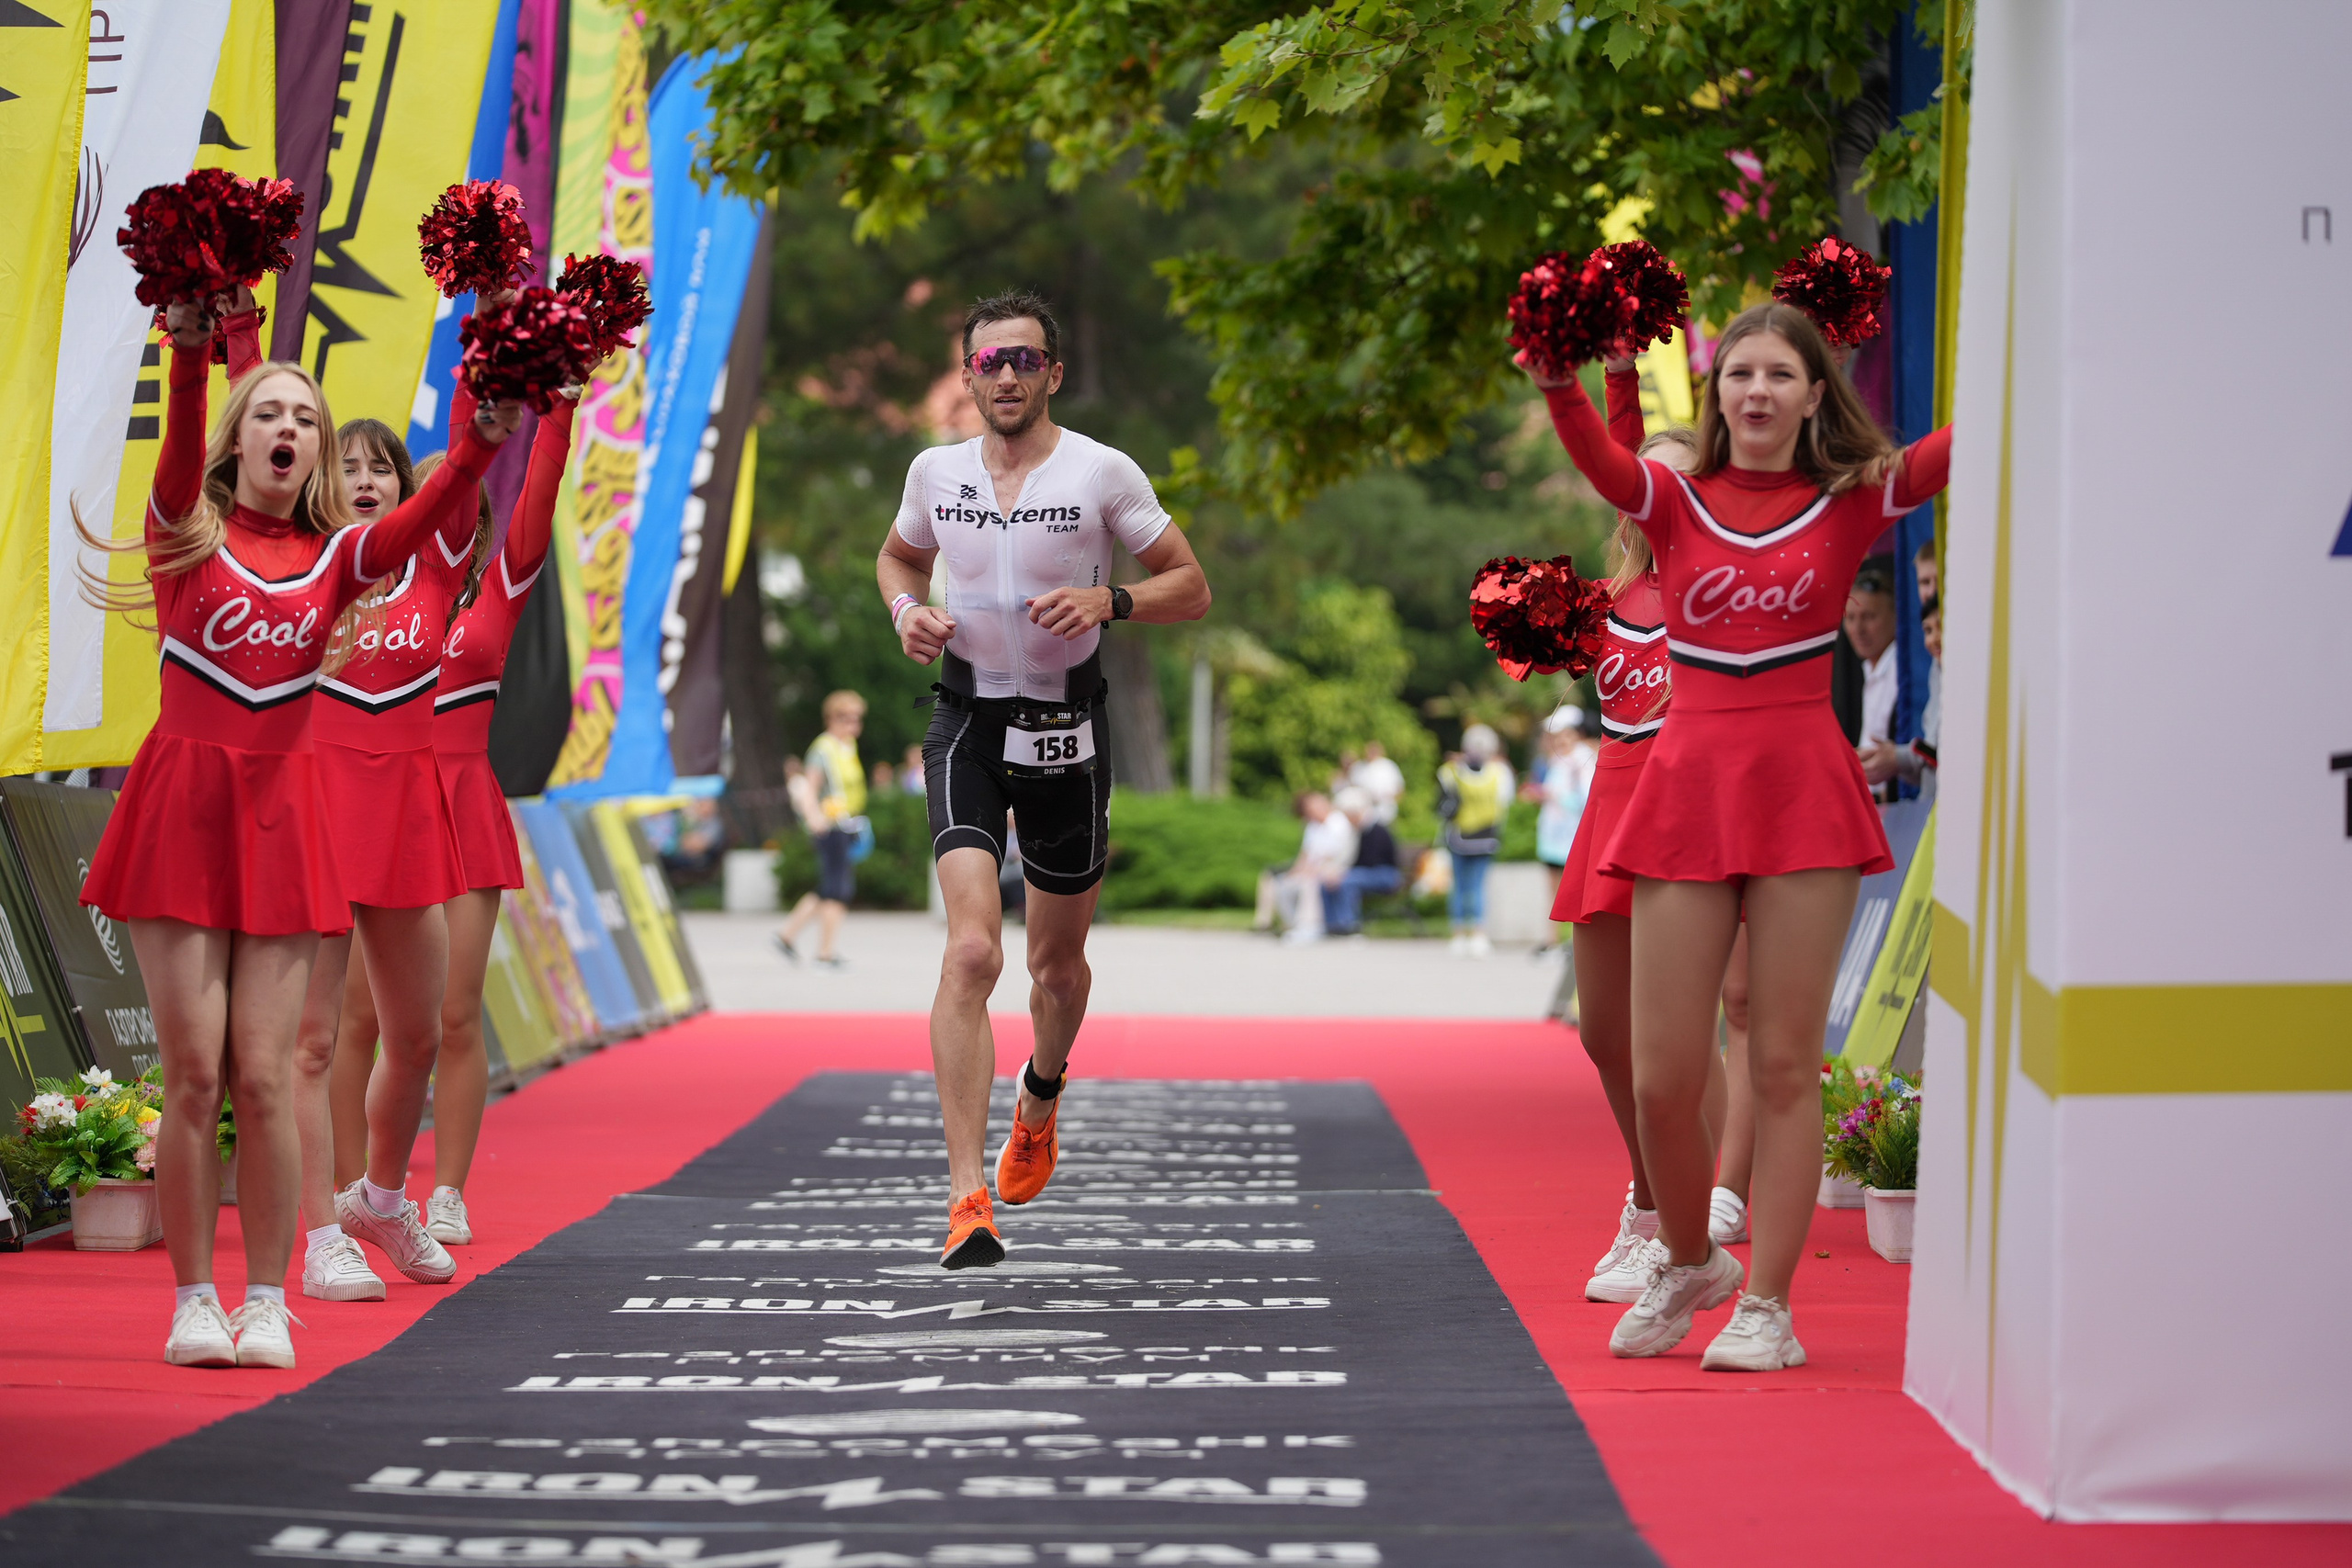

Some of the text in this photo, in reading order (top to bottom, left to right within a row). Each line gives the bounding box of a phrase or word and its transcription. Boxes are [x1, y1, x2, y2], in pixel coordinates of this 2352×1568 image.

[934, 502, 1081, 529] trisystems
[1046, 525, 1079, 533] TEAM
[1682, 565, 1815, 626] Cool
[202, 596, 318, 652] Cool
[1033, 735, 1079, 761] 158
[1044, 767, 1066, 775] DENIS
[695, 1237, 1315, 1249] IRON STAR
[622, 1297, 1331, 1310] IRON STAR
[516, 1371, 1348, 1388] IRON STAR
[367, 1467, 1367, 1496] IRON STAR
[269, 1526, 1382, 1564] IRON STAR
